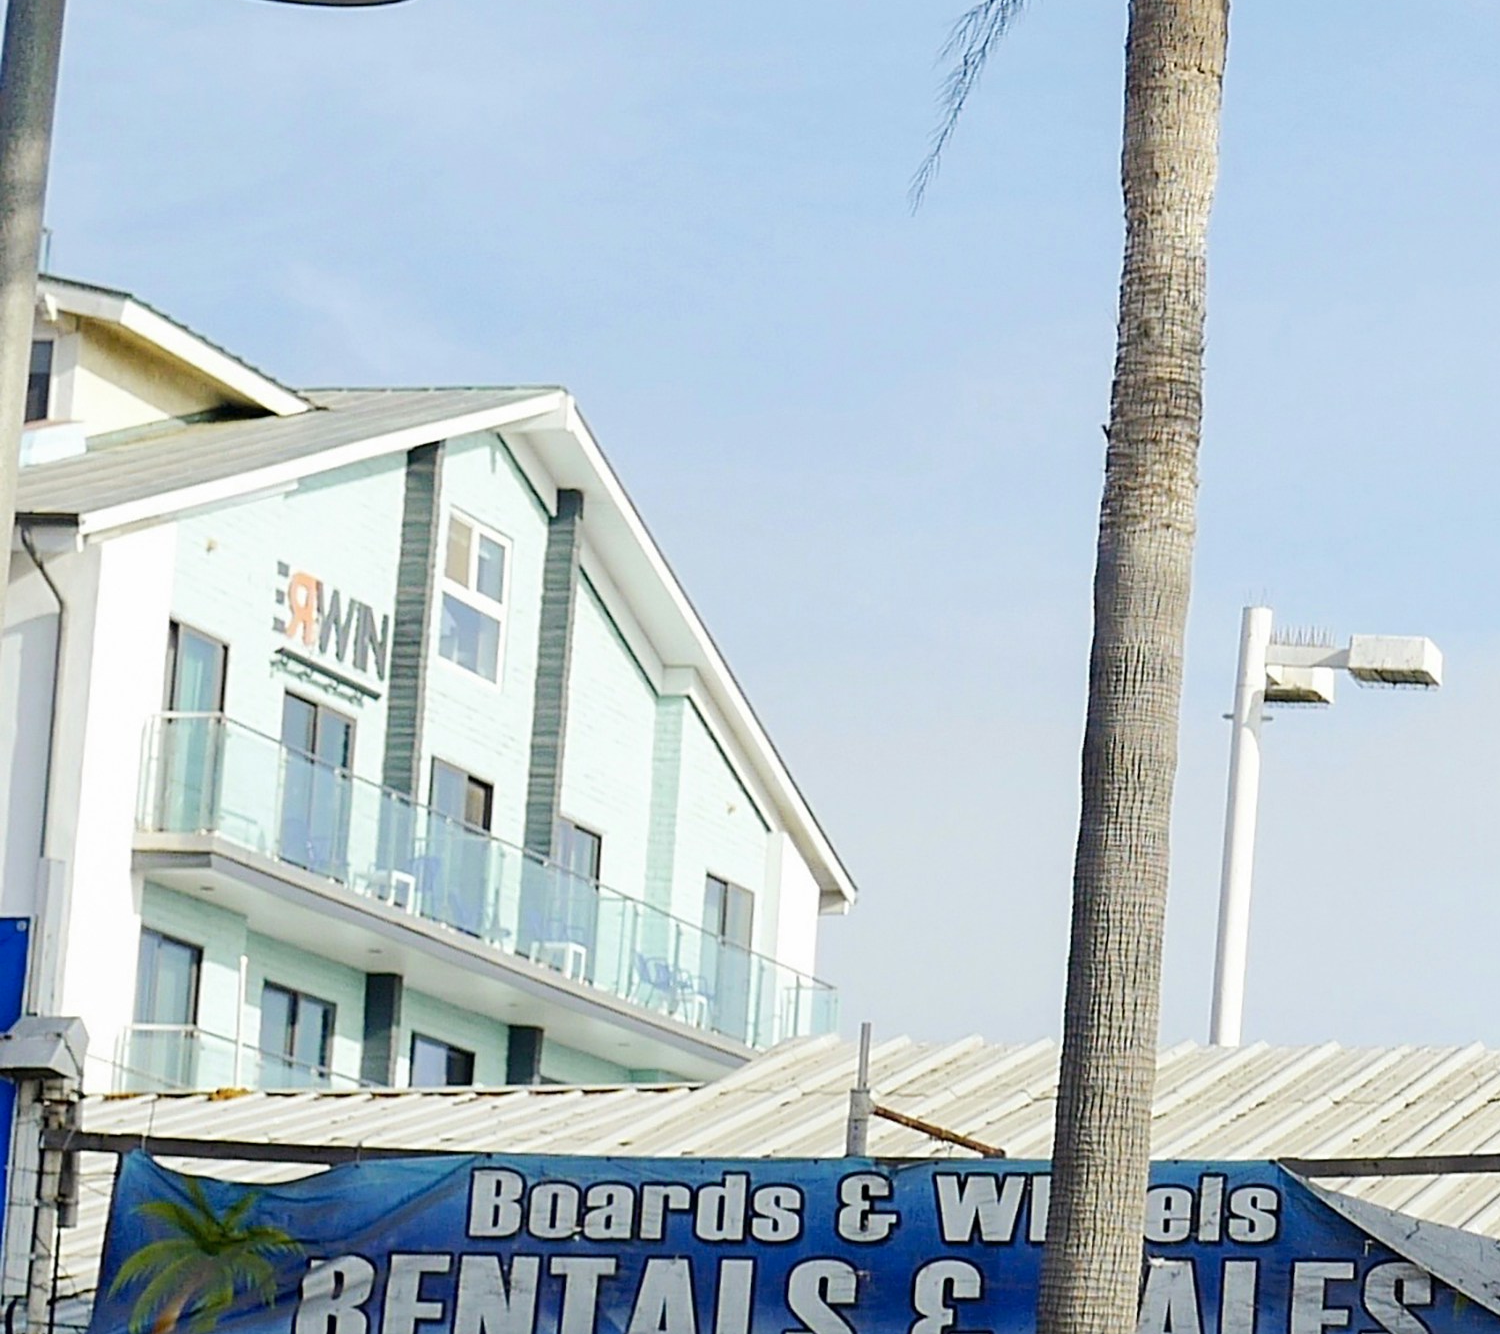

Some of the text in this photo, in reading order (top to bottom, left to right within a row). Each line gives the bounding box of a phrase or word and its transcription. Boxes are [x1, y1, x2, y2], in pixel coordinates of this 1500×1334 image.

[467, 1167, 1281, 1246] Boards & Wels
